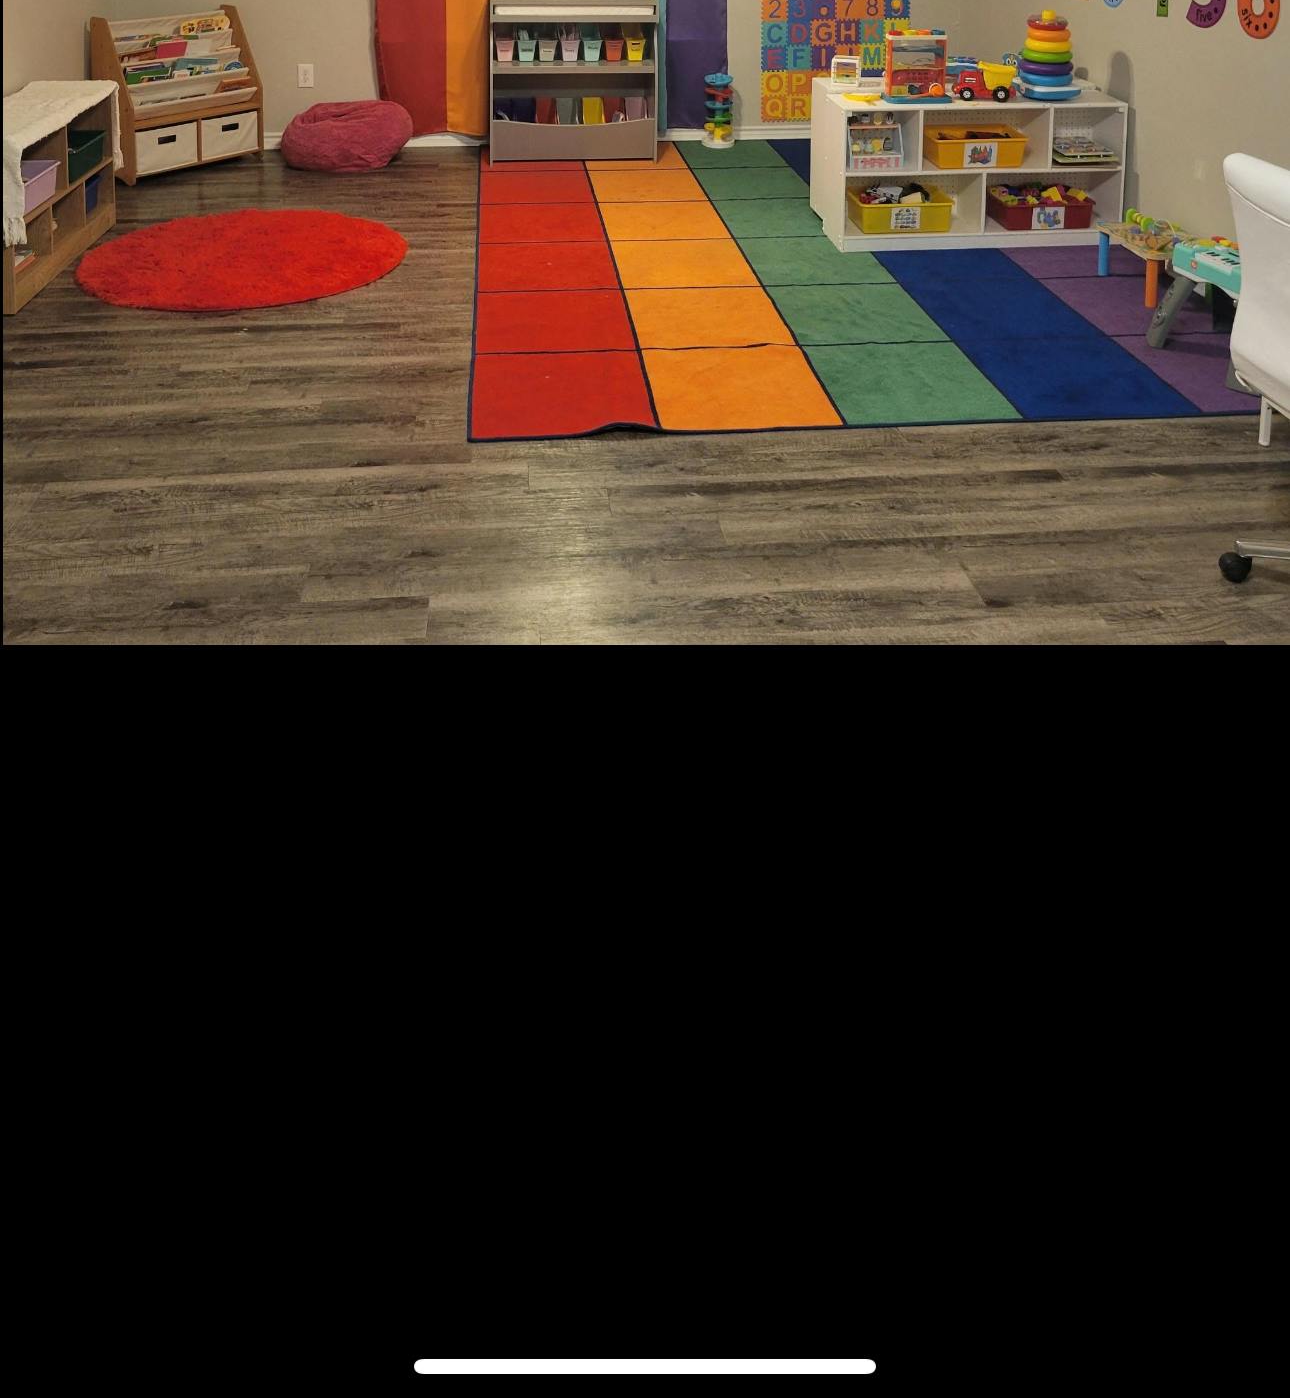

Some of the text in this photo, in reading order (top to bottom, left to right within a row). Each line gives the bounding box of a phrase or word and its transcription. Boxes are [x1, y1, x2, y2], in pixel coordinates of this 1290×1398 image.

[768, 0, 782, 18] 2
[1196, 8, 1212, 22] five
[1241, 7, 1252, 28] six
[766, 23, 783, 44] C
[790, 23, 807, 43] D
[815, 22, 832, 42] G
[840, 22, 856, 42] H
[863, 22, 880, 41] K
[767, 48, 782, 68] E
[792, 48, 805, 67] F
[863, 47, 881, 65] M
[765, 73, 807, 93] O P
[765, 98, 805, 118] Q R
